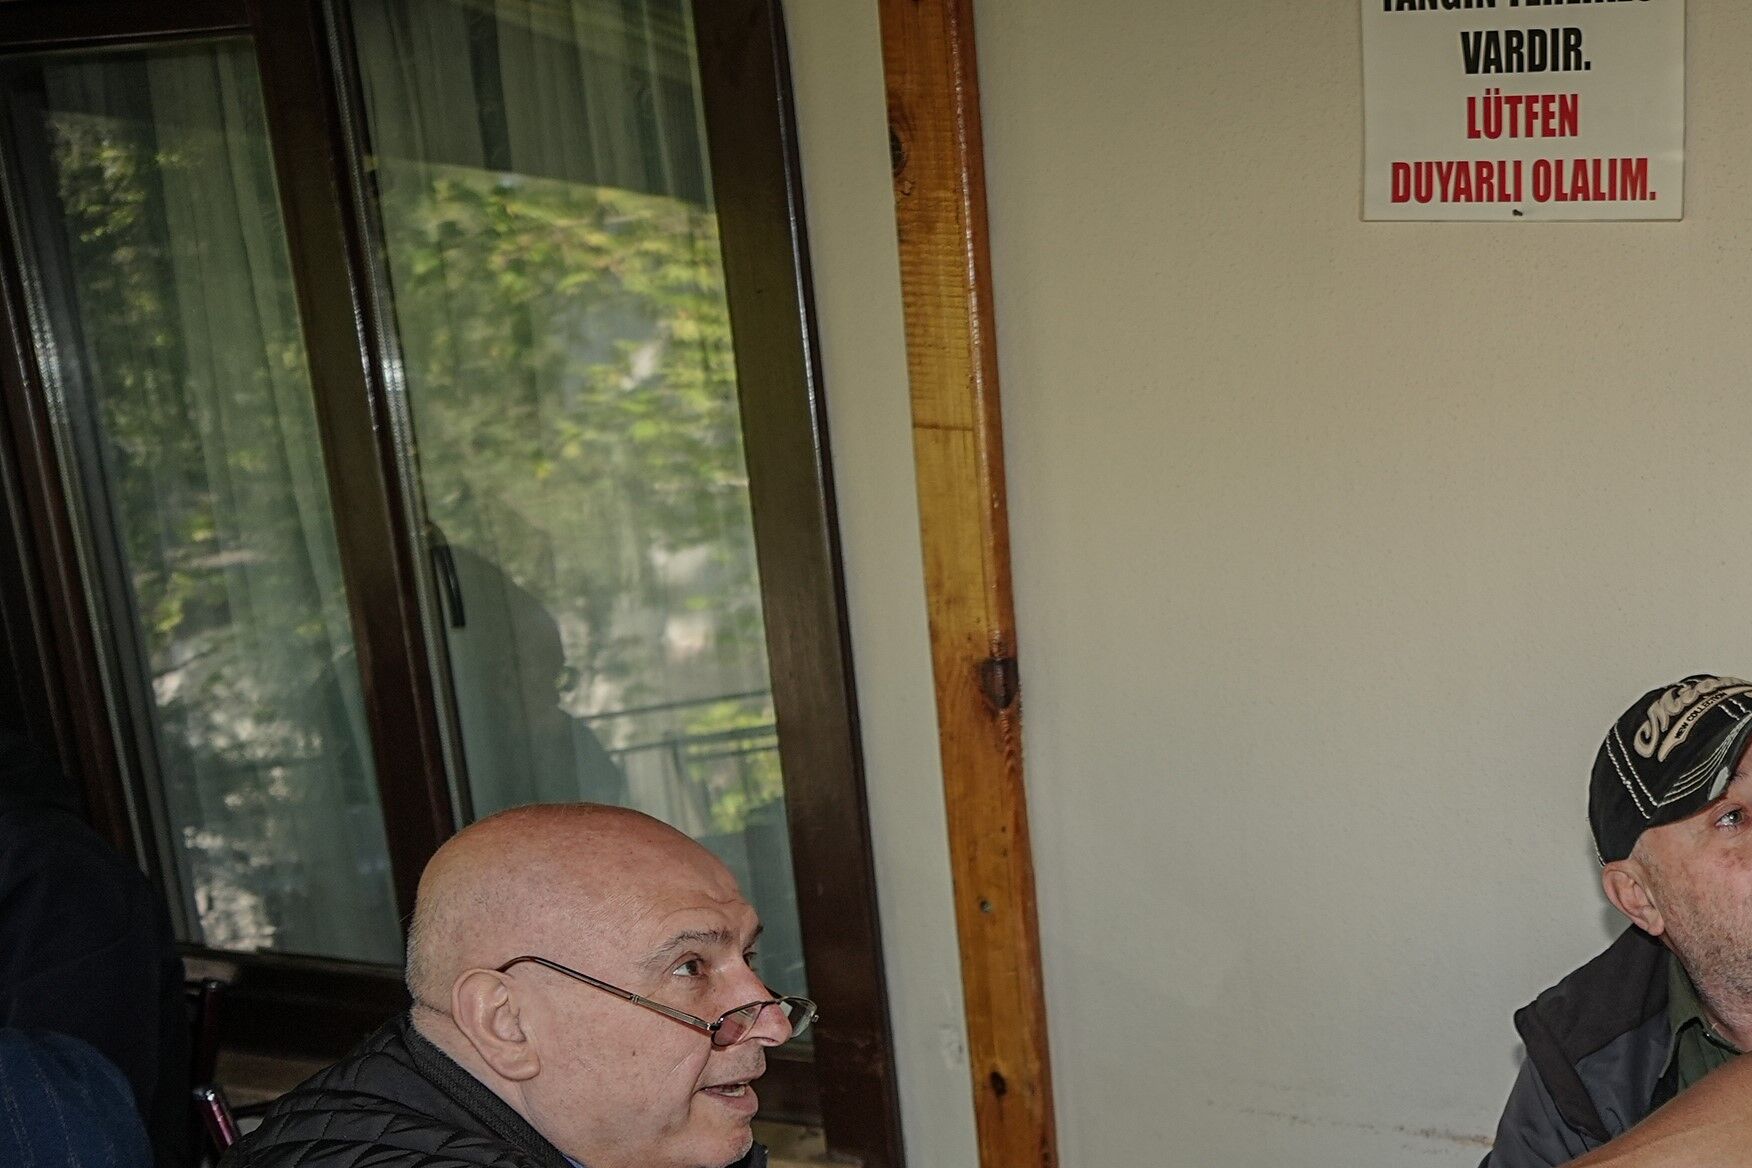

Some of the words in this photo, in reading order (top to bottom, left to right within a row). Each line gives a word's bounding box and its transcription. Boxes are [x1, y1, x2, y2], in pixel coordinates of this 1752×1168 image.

[1460, 27, 1592, 75] VARDIR.
[1466, 88, 1579, 139] LÜTFEN
[1390, 160, 1523, 204] DUYARLI
[1531, 157, 1657, 203] OLALIM.
[1674, 721, 1689, 739] NEW
[1687, 691, 1728, 723] COLLECTION
